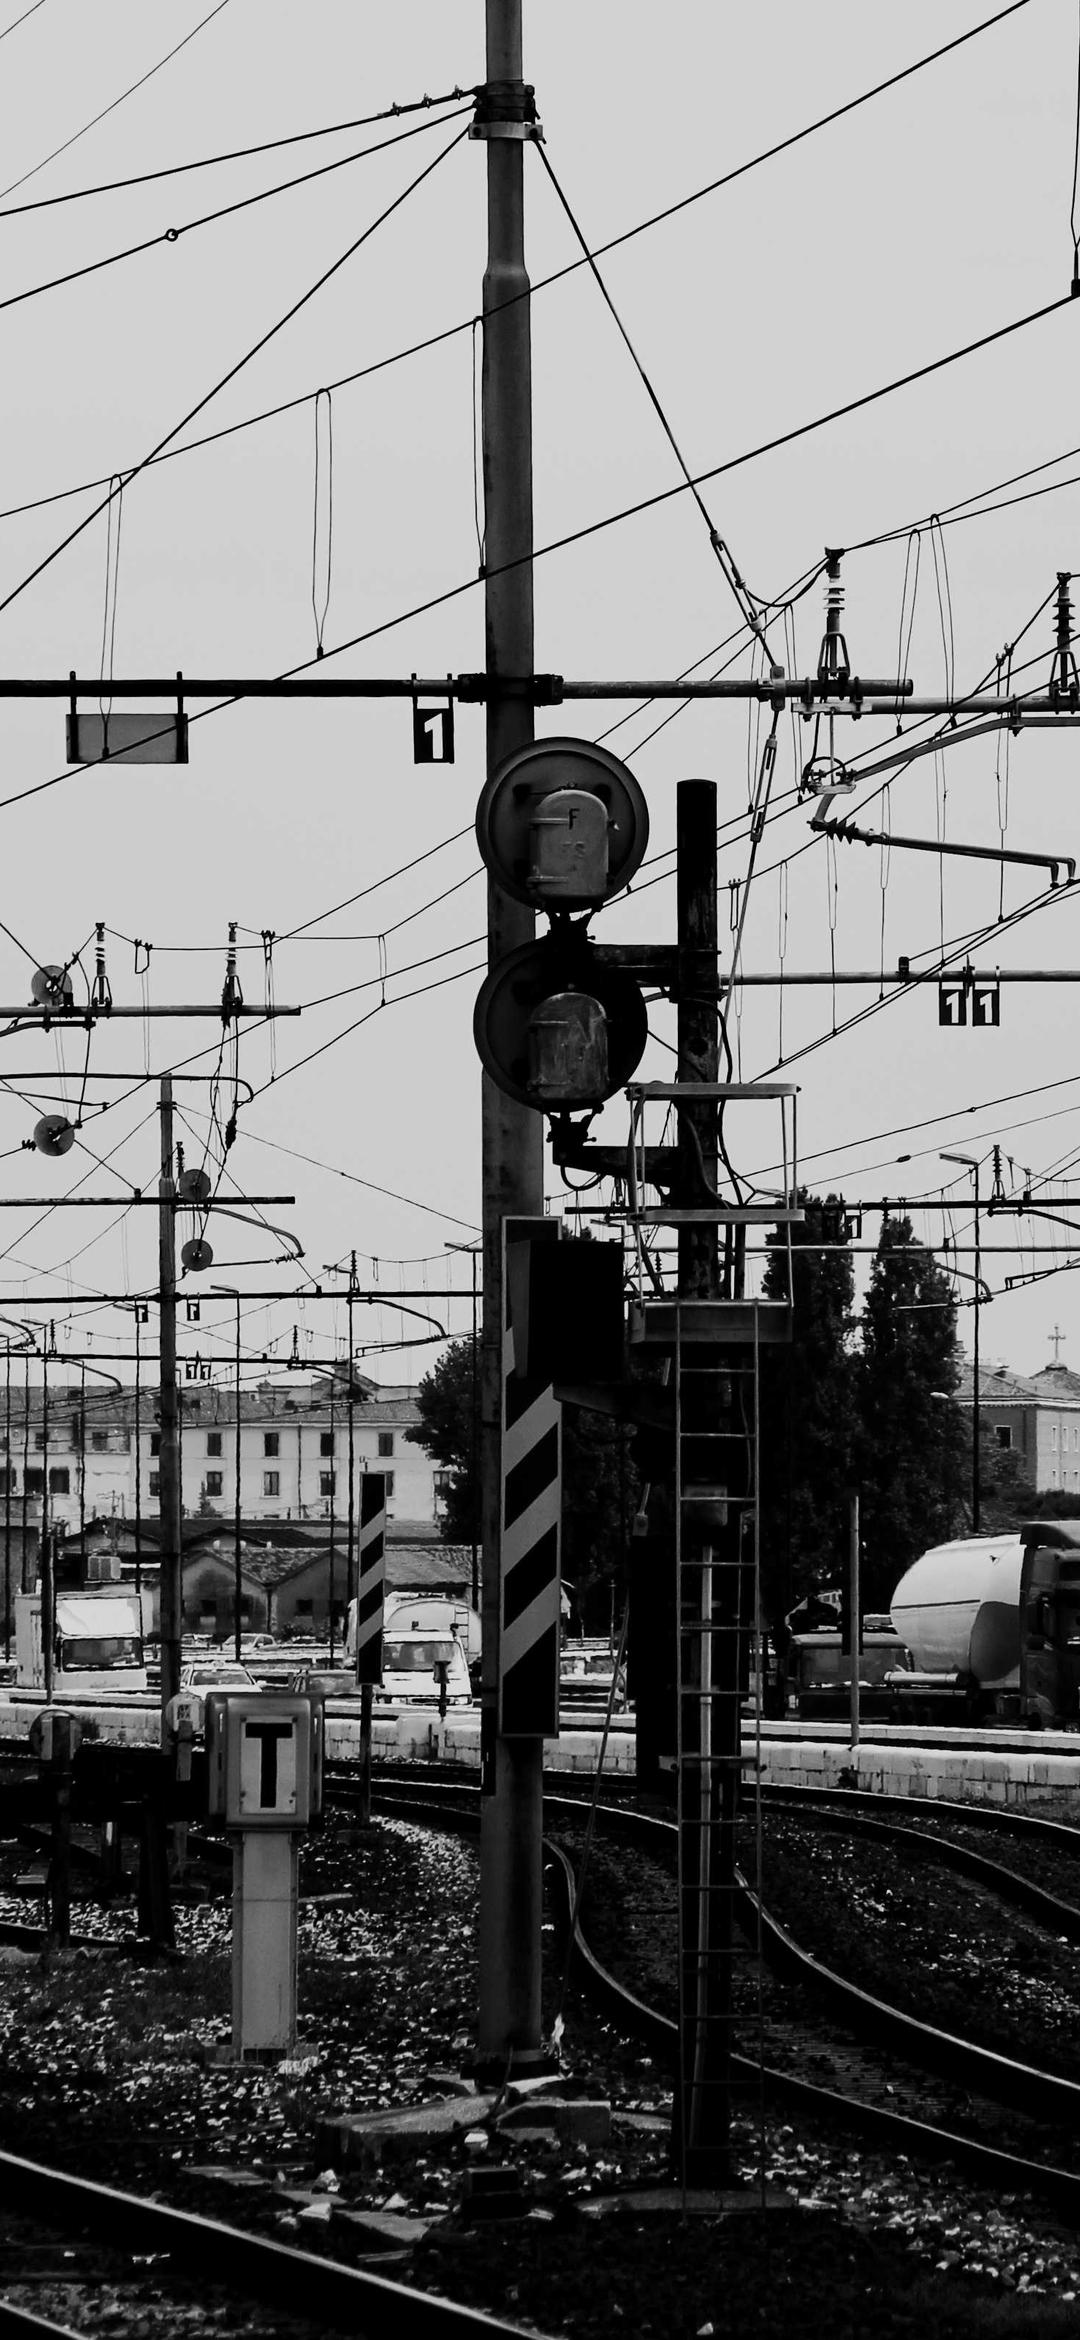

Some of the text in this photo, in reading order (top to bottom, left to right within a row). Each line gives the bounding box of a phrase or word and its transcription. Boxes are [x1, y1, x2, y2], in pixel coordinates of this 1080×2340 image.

[424, 712, 444, 759] 1
[568, 807, 581, 830] F
[946, 991, 959, 1023] 1
[979, 992, 993, 1023] 1
[245, 1722, 293, 1808] T
